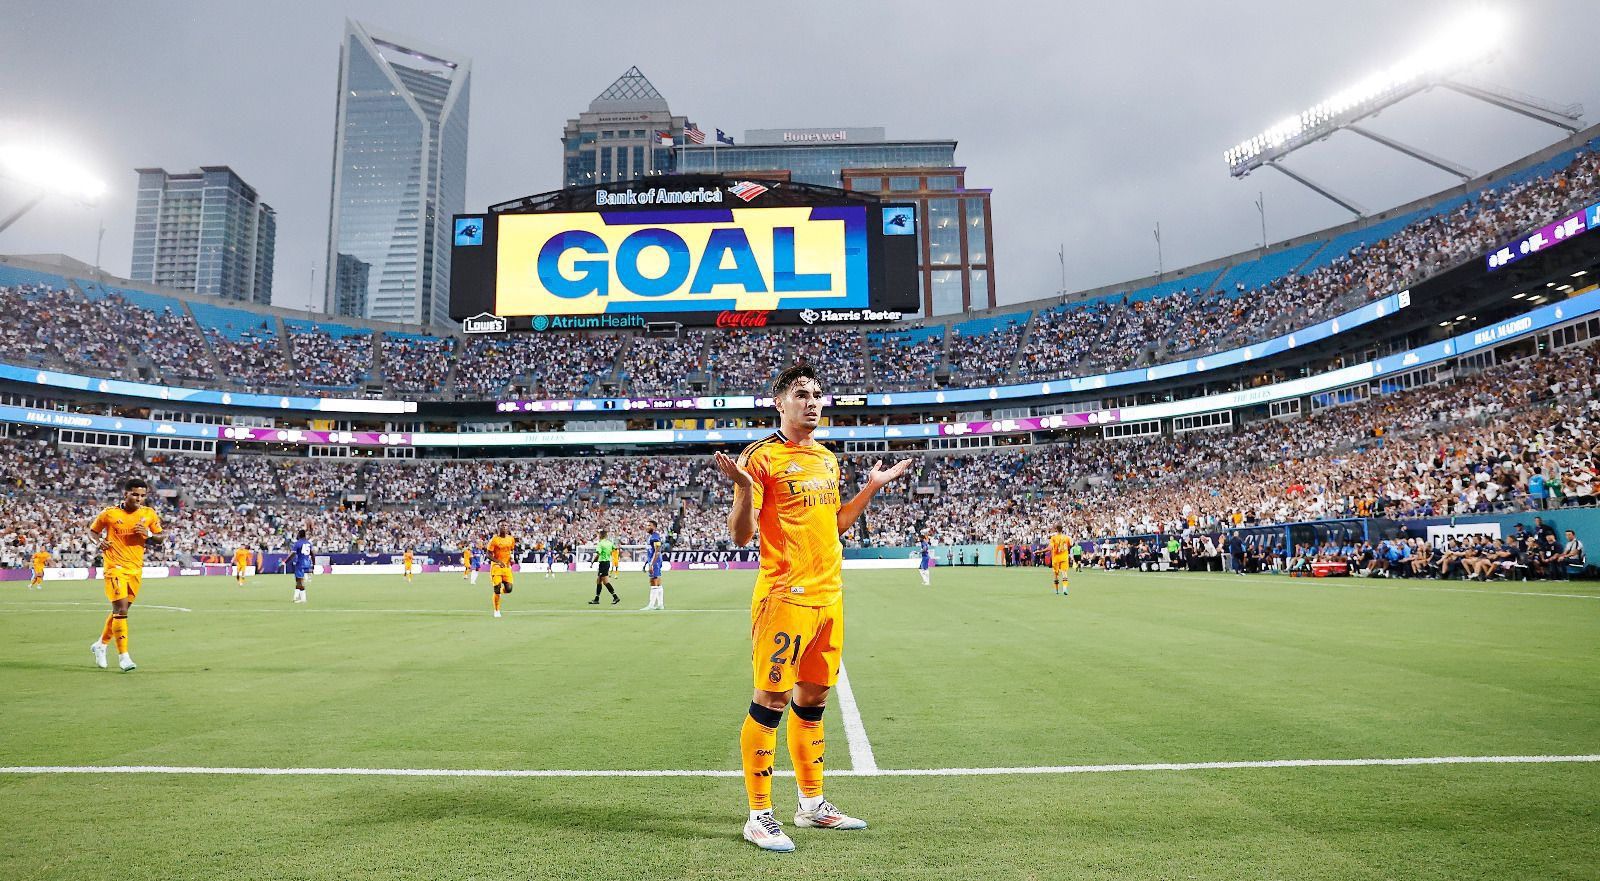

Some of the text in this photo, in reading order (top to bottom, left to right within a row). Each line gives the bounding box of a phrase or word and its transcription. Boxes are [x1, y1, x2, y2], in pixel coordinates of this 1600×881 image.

[783, 130, 847, 142] Honeywell
[595, 187, 723, 206] Bank of America
[537, 227, 832, 298] GOAL
[551, 314, 646, 329] Atrium Health
[820, 310, 902, 322] Harris Teeter
[770, 631, 802, 666] 21
